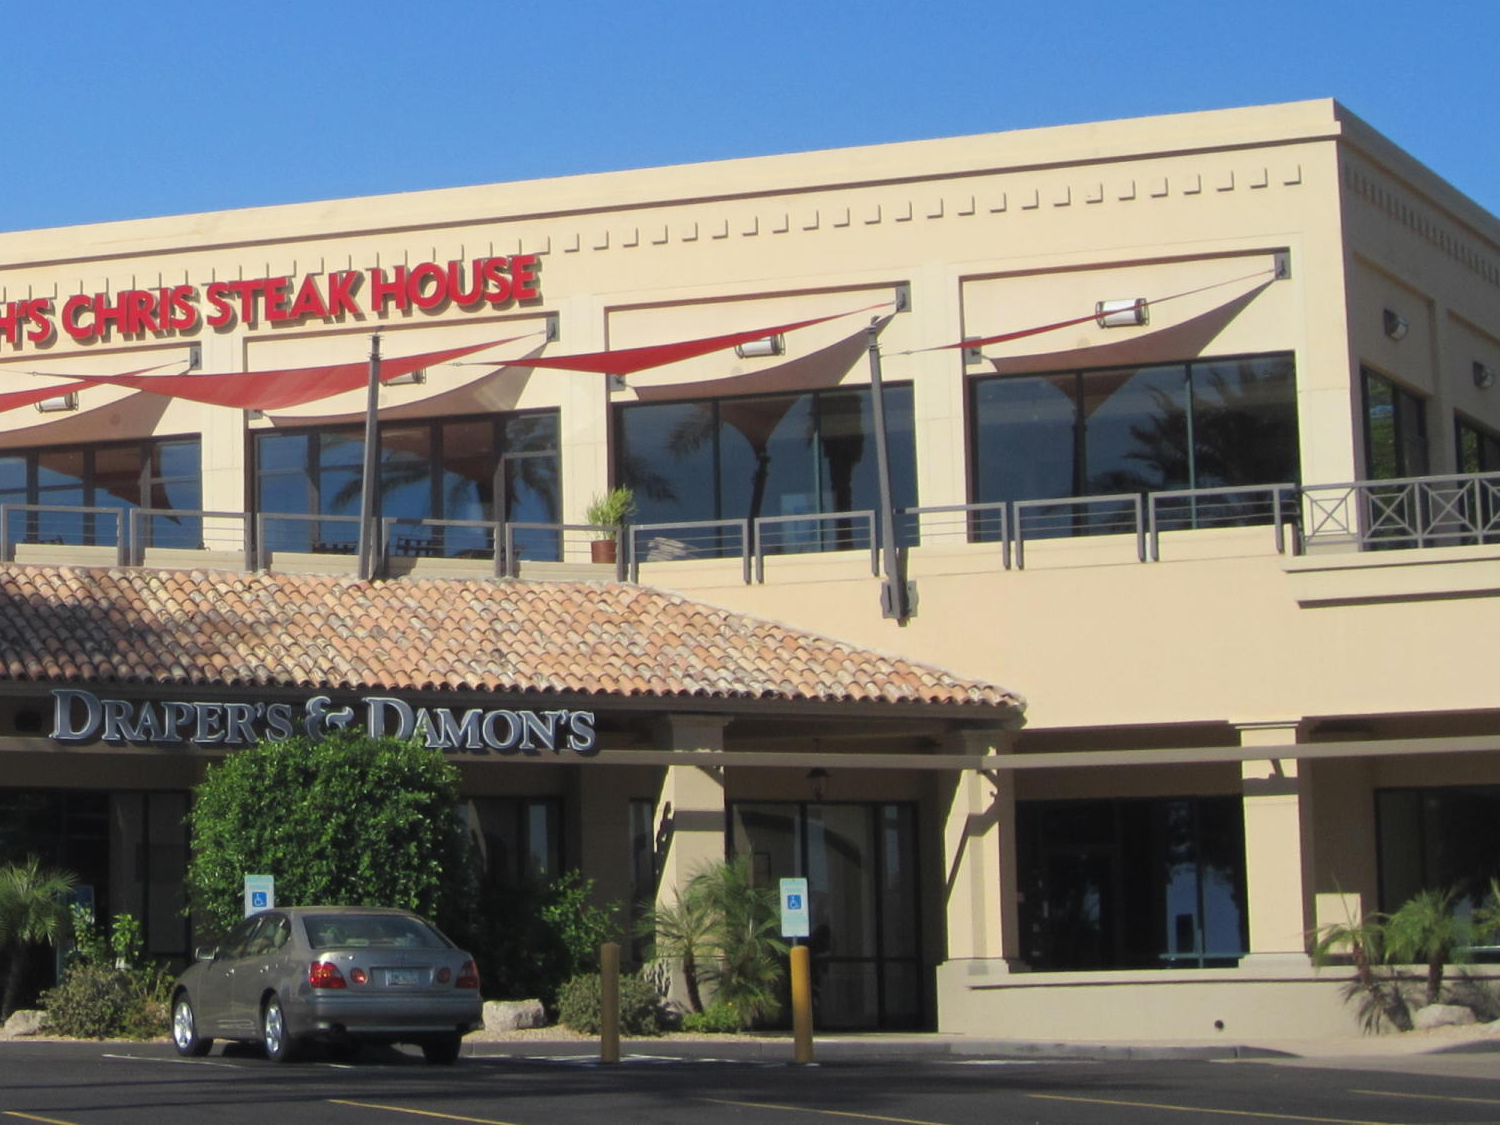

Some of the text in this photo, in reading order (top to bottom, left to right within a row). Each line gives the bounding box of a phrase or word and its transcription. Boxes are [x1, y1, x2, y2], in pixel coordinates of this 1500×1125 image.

[61, 284, 199, 340] CHRIS
[206, 269, 360, 327] STEAK
[370, 253, 539, 313] HOUSE
[49, 689, 597, 751] DRAPER'S & DAMON'S
